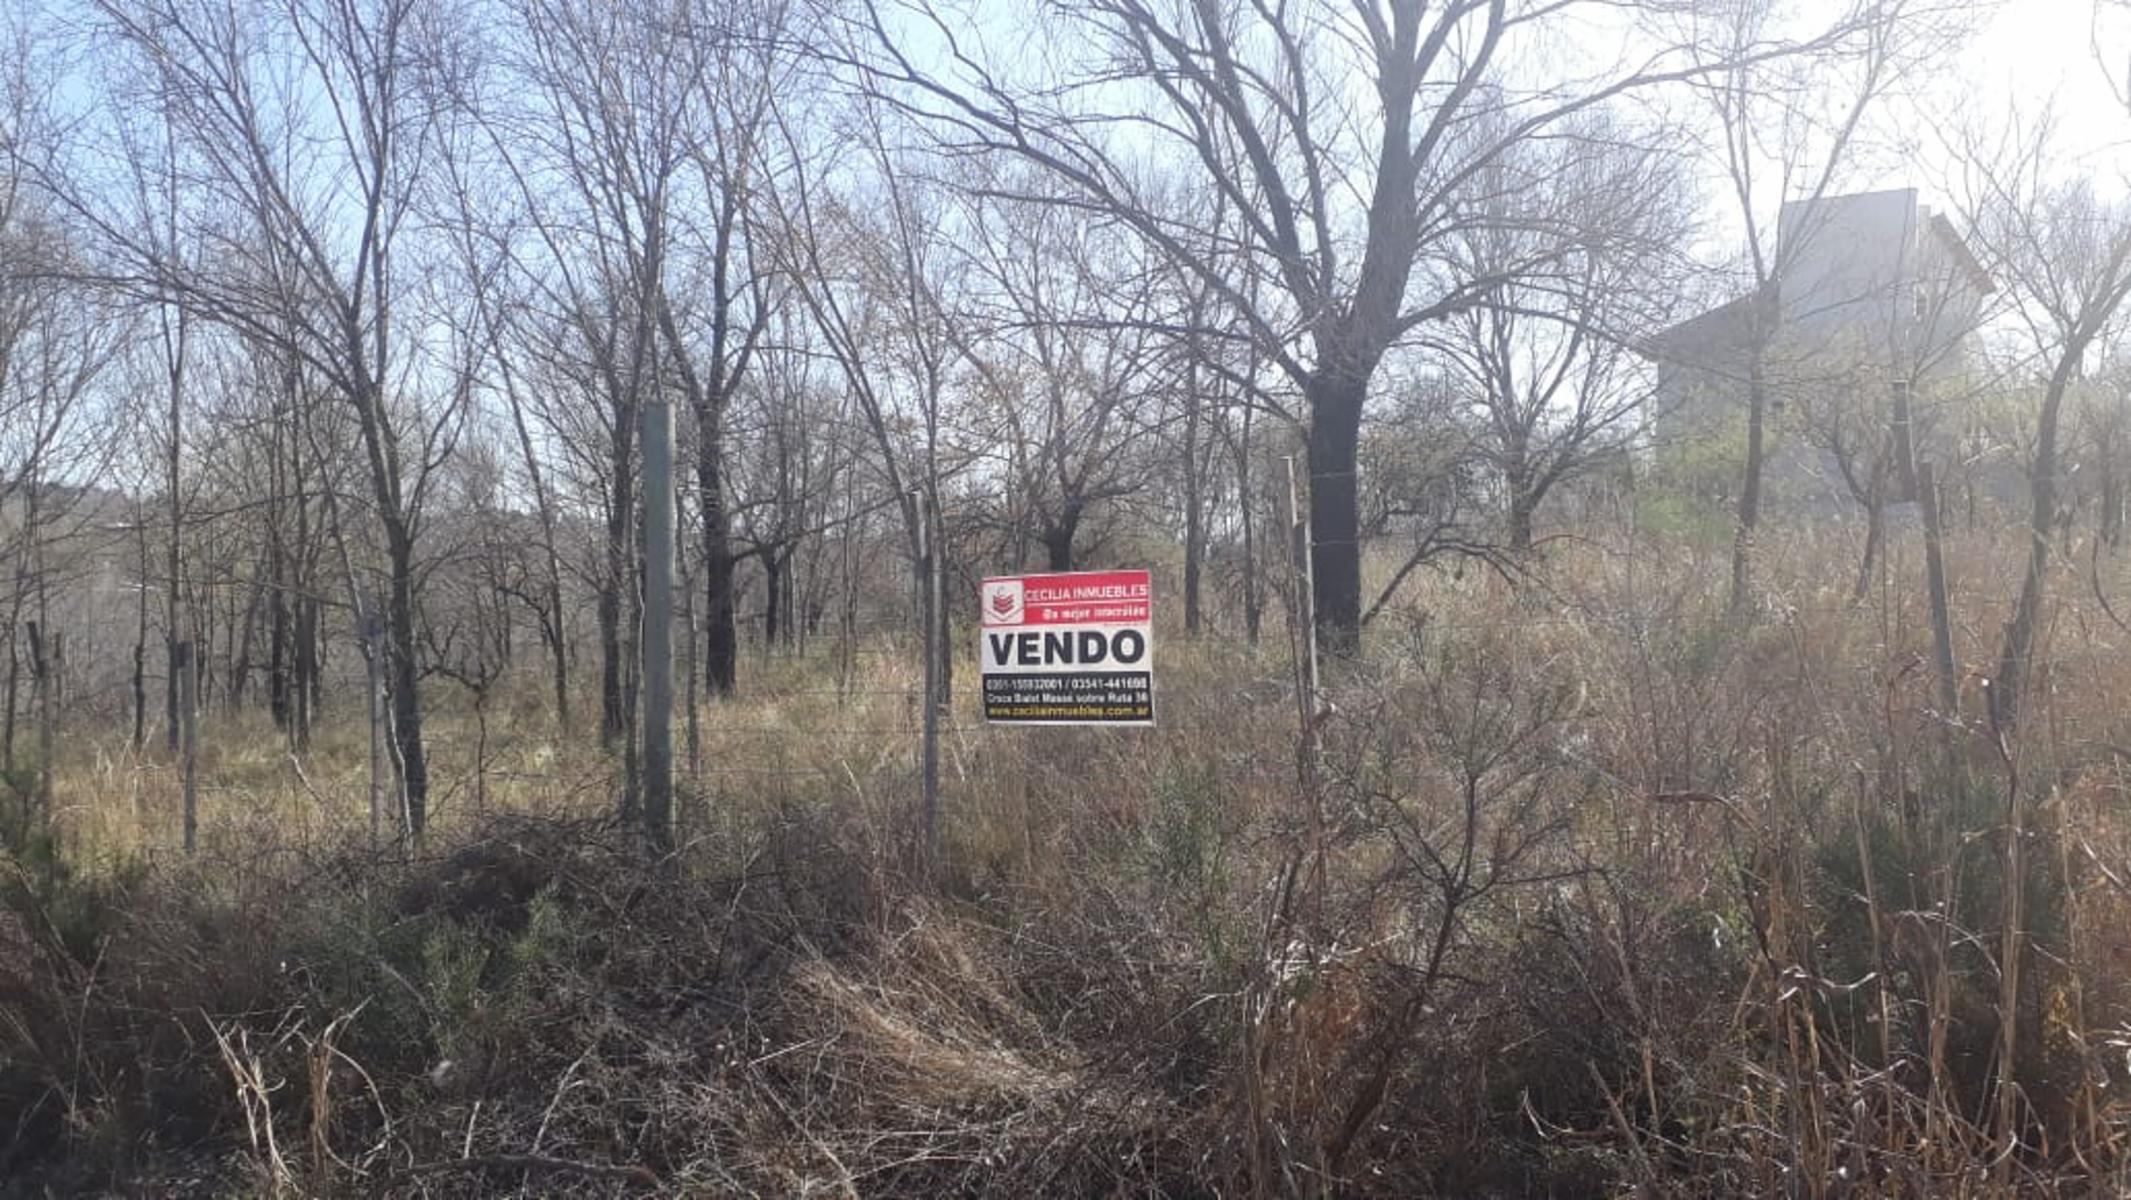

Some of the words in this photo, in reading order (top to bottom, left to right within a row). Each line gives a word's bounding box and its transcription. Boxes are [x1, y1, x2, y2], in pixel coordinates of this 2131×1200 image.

[1073, 584, 1148, 599] INMUEBLES
[989, 629, 1145, 666] VENDO
[1108, 691, 1133, 703] Ruta
